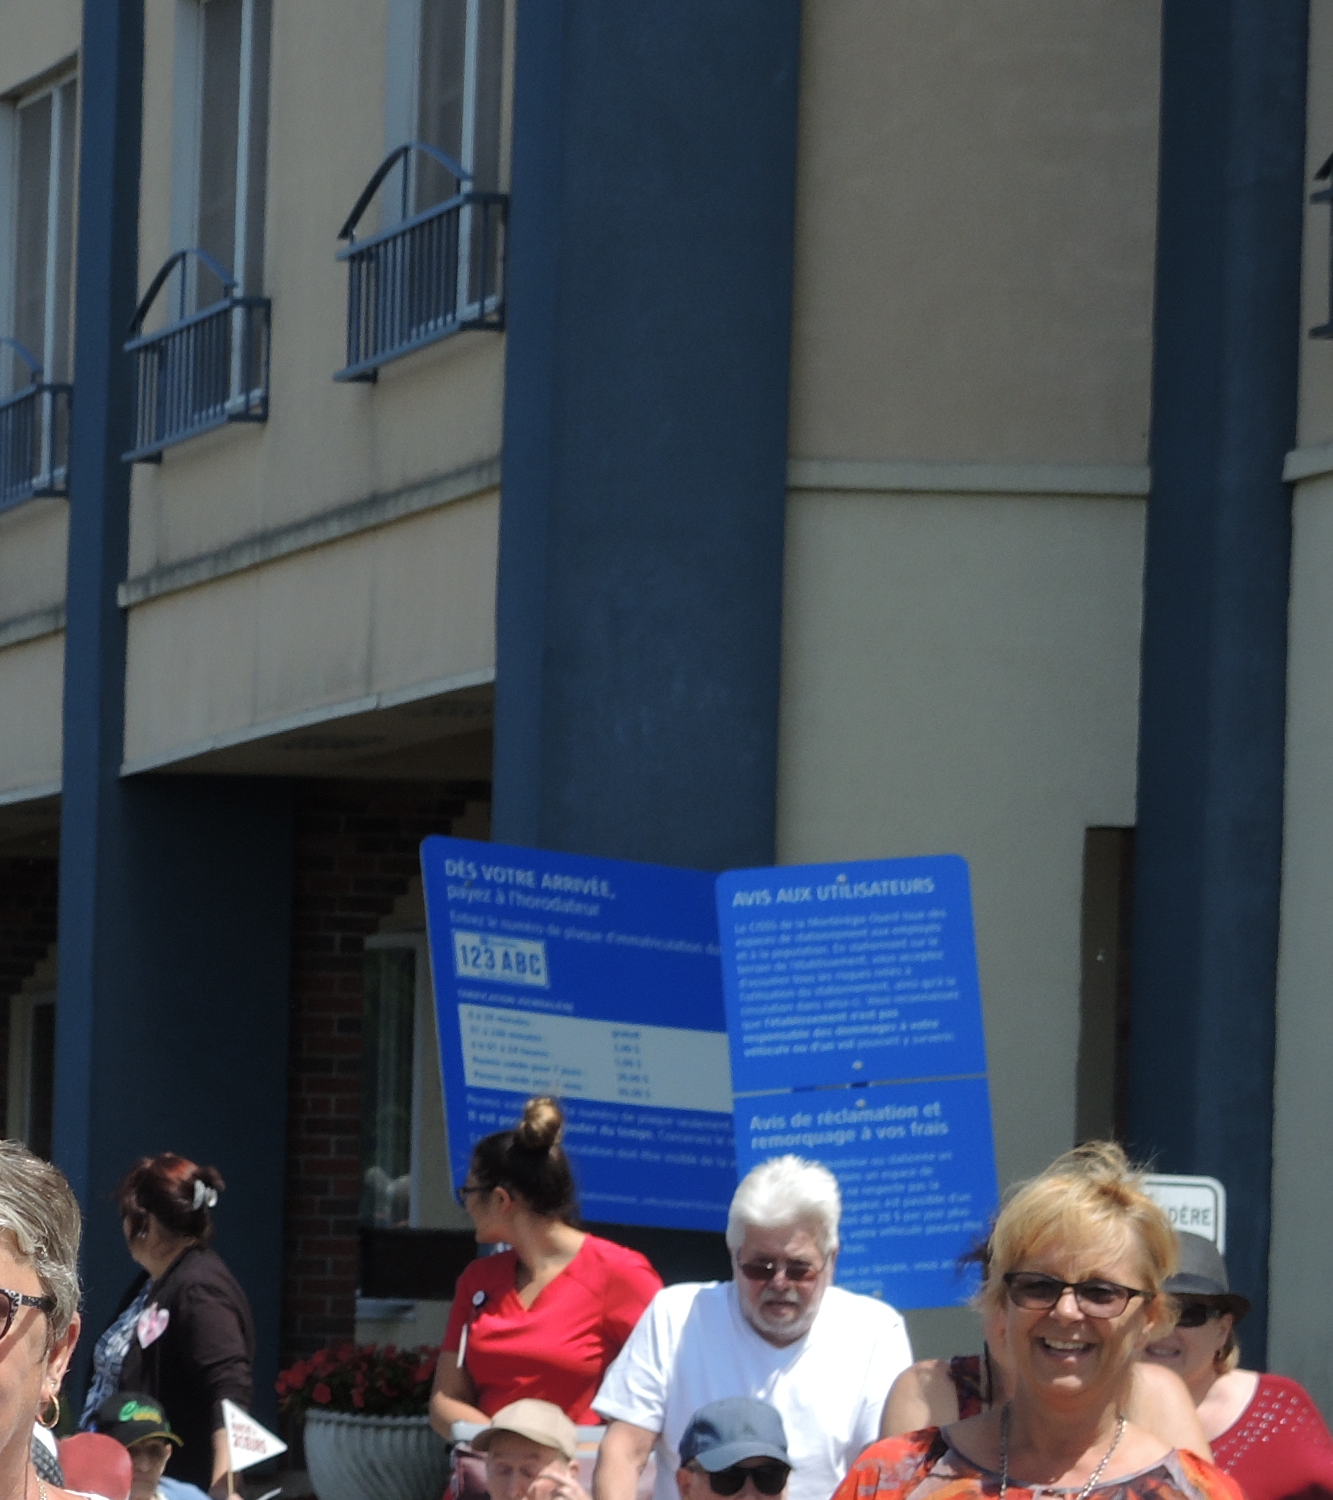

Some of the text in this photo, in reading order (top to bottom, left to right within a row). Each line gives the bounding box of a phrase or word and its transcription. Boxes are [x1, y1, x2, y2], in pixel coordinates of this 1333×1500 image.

[481, 865, 535, 888] VOTRE
[447, 885, 491, 903] payez
[732, 877, 935, 907] AVIS AUX UTILISATEURS
[461, 945, 541, 976] 123 ABC
[750, 1102, 941, 1130] Avis de réclamation et
[751, 1120, 949, 1149] remorquage à vos frais
